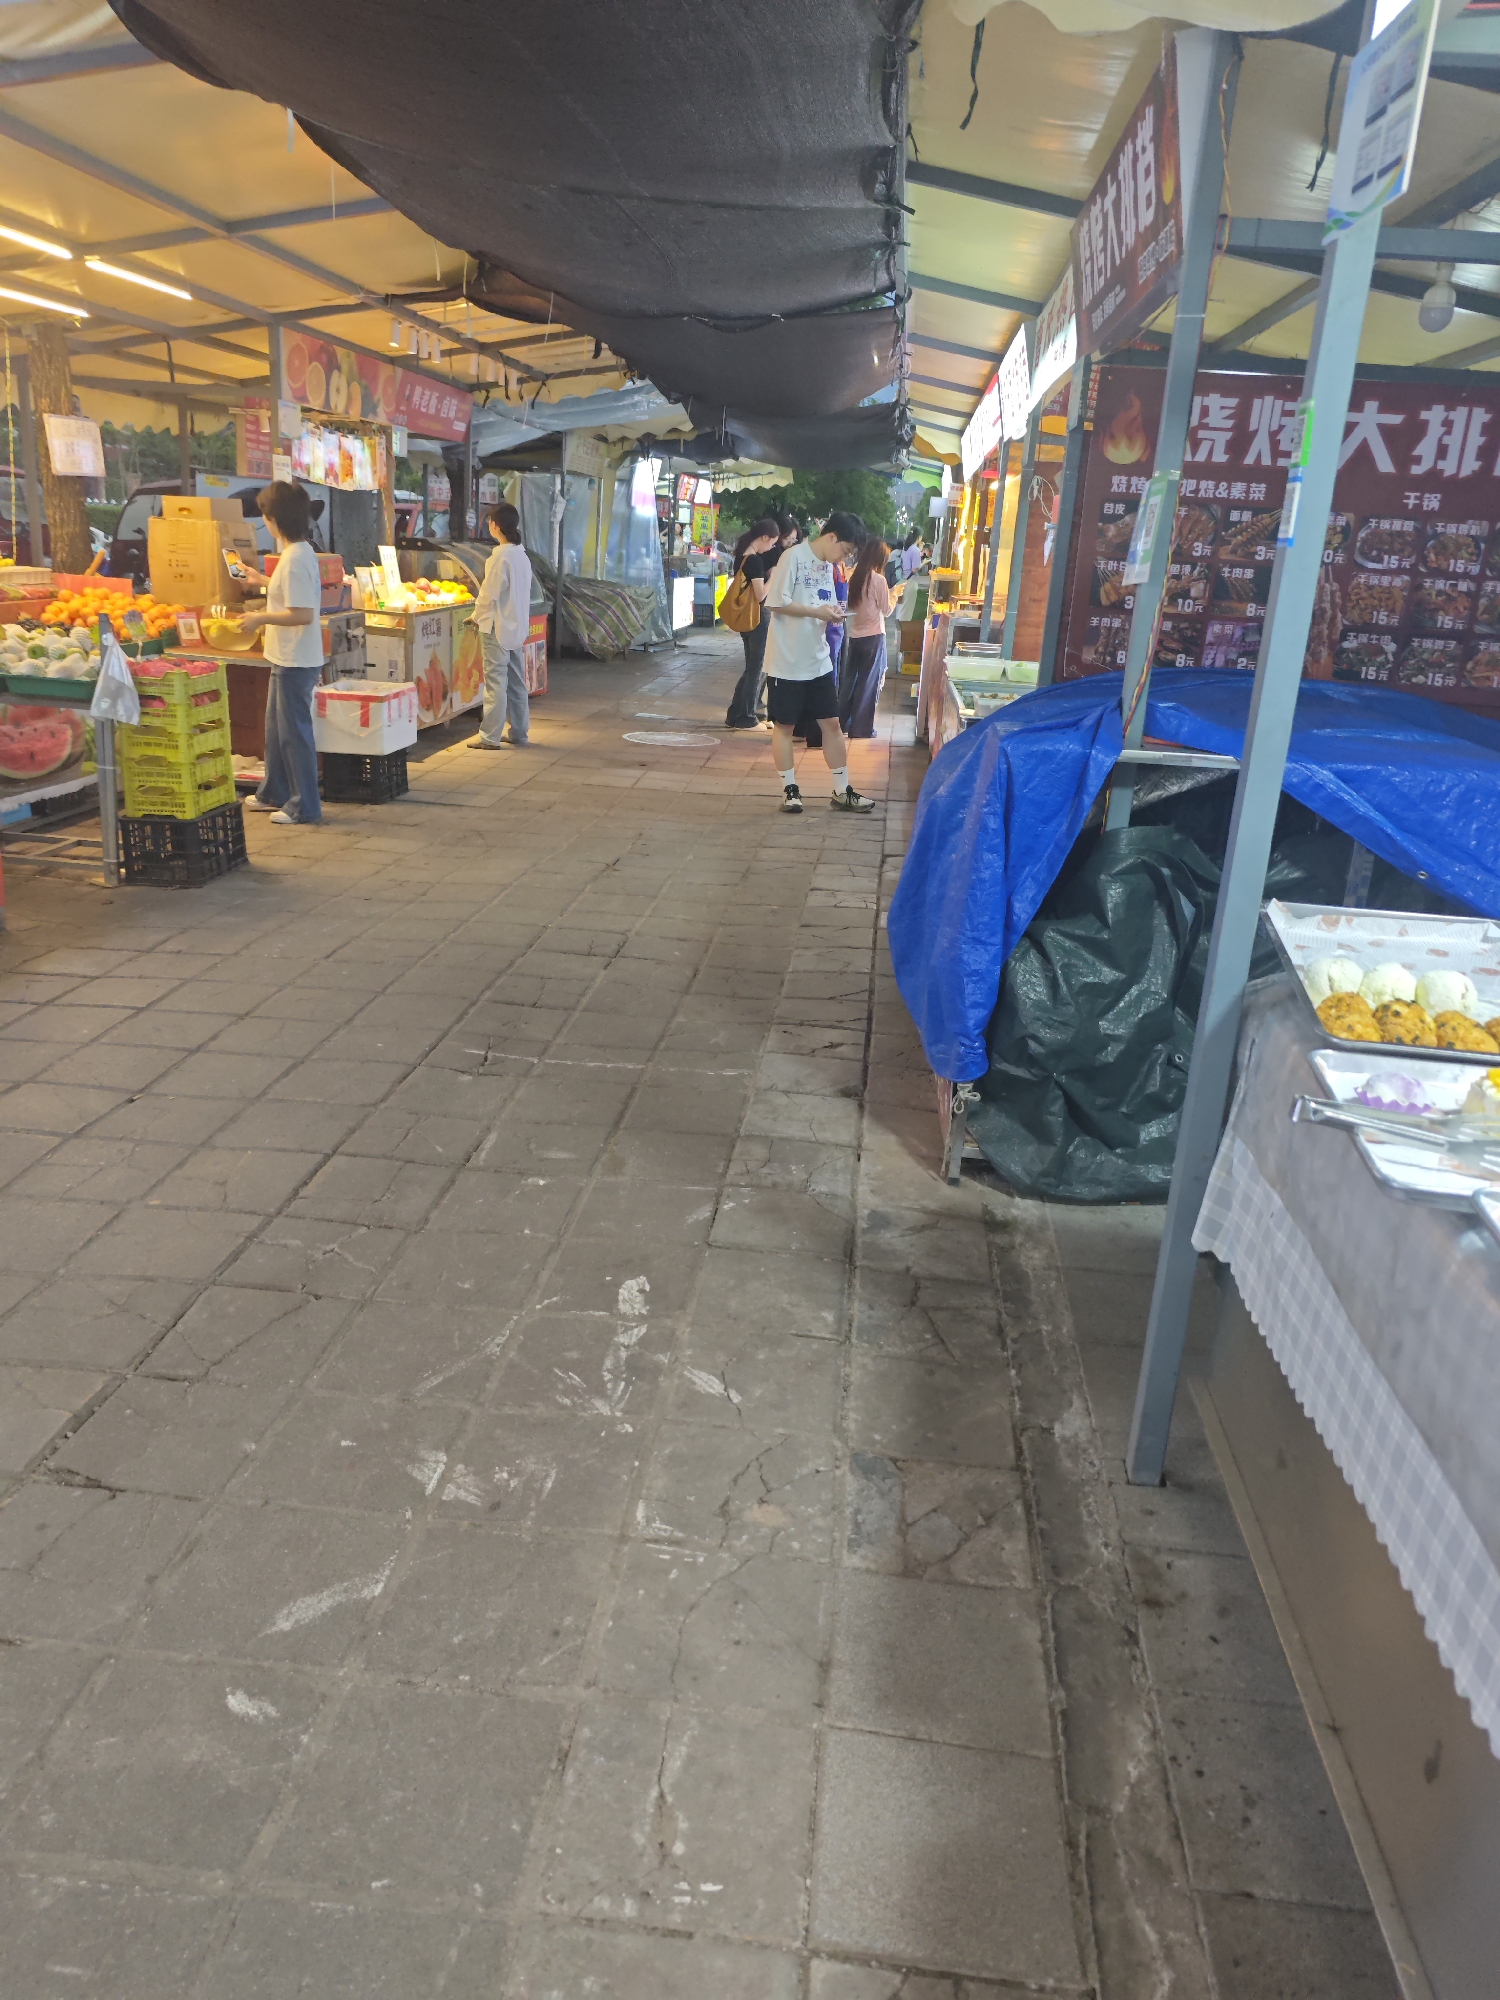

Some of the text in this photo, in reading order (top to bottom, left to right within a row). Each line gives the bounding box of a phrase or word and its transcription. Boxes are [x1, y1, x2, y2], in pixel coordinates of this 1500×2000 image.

[1184, 393, 1500, 478] 烧烤大排
[1403, 491, 1442, 511] 干锅
[1192, 542, 1212, 557] 3元
[1254, 546, 1275, 561] 3元
[1382, 555, 1411, 569] 15元
[1449, 559, 1478, 573] 15元
[1221, 567, 1254, 579] 牛肉串
[1177, 598, 1203, 613] 10元
[1246, 603, 1266, 617] 8元
[1089, 616, 1122, 628] 羊肉串
[1372, 611, 1400, 626] 15元
[1437, 616, 1465, 630] 15元
[1346, 632, 1392, 646] 干锅牛肉
[1175, 653, 1195, 668] 8元
[1237, 657, 1257, 671] 2元
[1361, 666, 1389, 681] 15元
[1427, 672, 1457, 687] 15元
